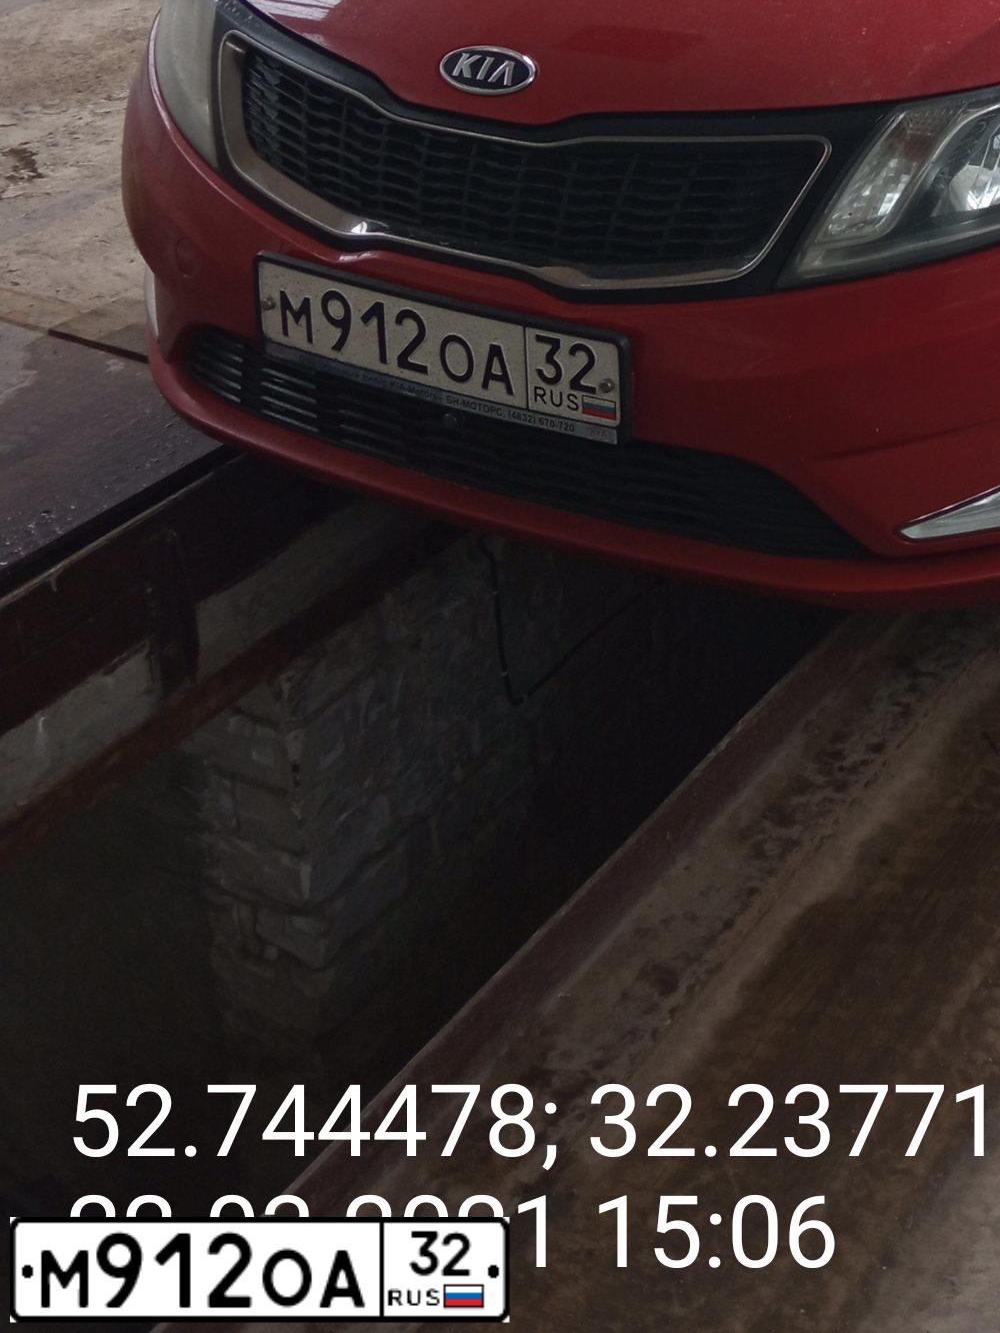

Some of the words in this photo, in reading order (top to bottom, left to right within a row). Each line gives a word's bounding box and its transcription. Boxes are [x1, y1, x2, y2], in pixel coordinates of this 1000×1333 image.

[452, 52, 515, 86] KIA
[279, 289, 514, 396] М912ОА
[535, 334, 597, 394] 32
[534, 386, 579, 411] RUS
